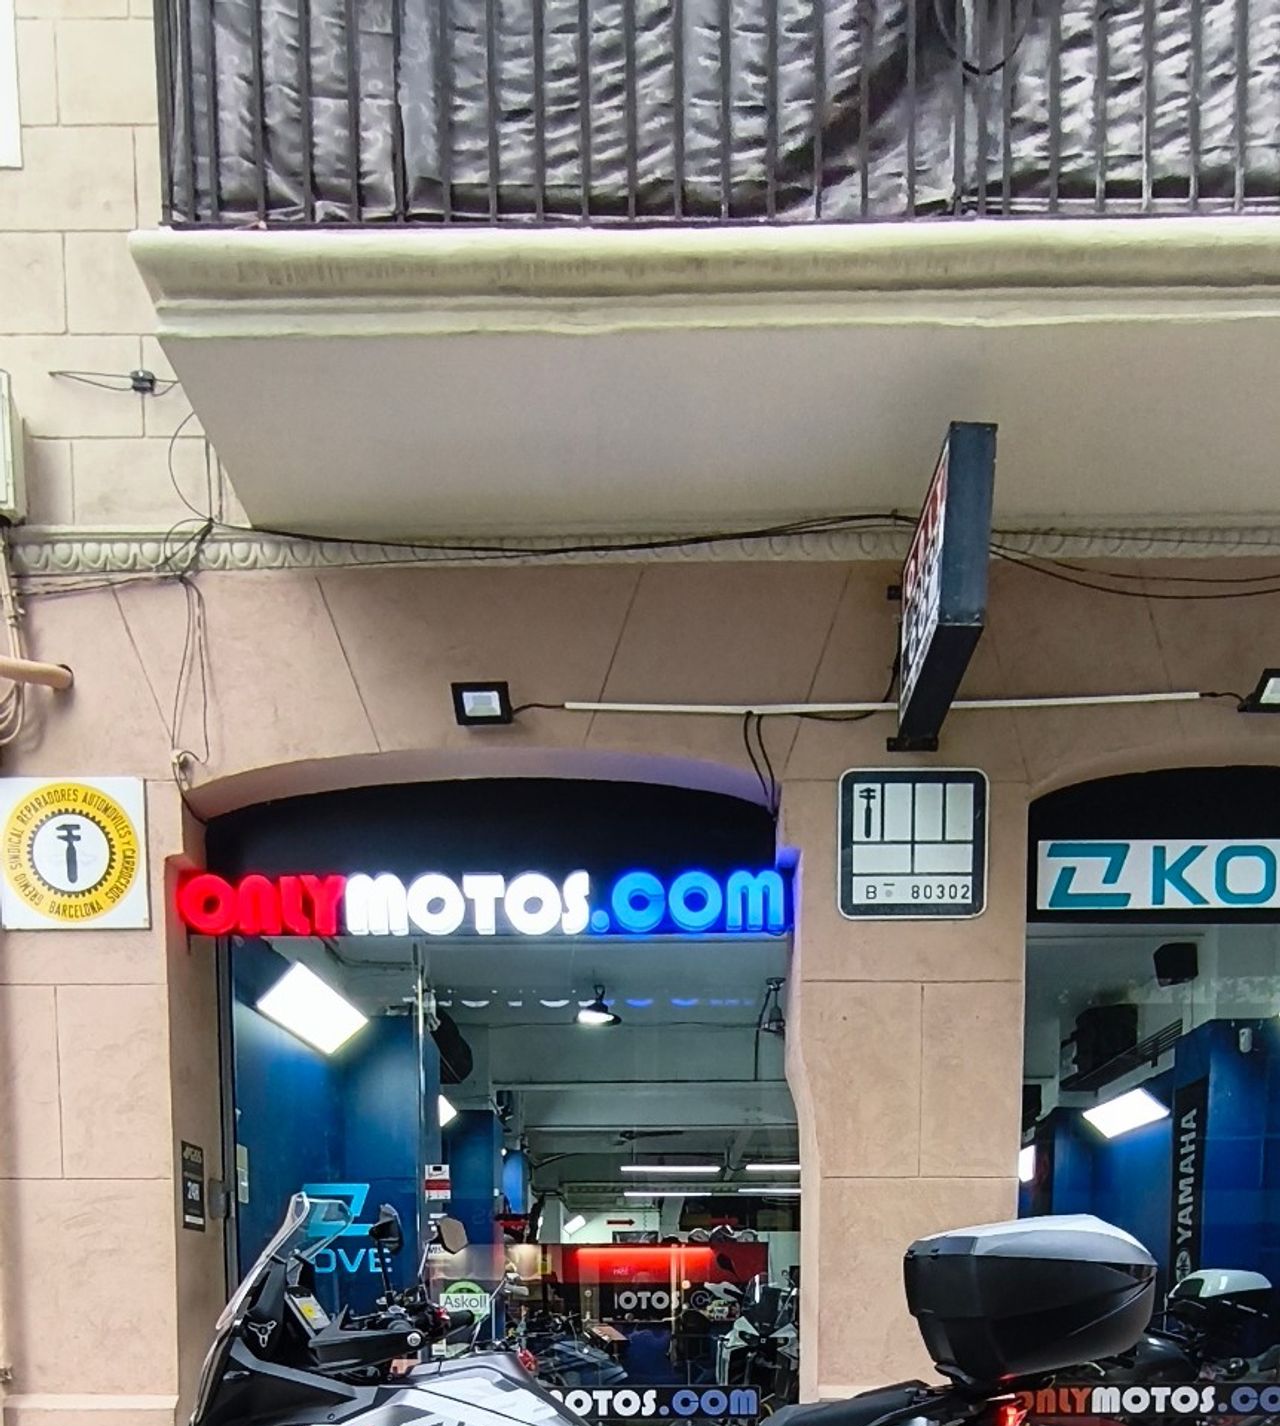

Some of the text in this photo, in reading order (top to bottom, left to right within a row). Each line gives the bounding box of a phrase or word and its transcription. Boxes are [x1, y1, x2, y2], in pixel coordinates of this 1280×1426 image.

[17, 788, 79, 825] REPARADORES
[82, 791, 132, 839] AUTOMOVILES
[8, 829, 24, 870] SINDICAL
[15, 873, 43, 906] GREMIO
[105, 848, 136, 903] CARROCEROS
[866, 884, 970, 900] B 80302
[49, 900, 103, 918] BARCELONA
[1176, 1108, 1197, 1245] YAMAHA
[295, 1248, 393, 1273] OVE
[444, 1295, 487, 1308] Askoll
